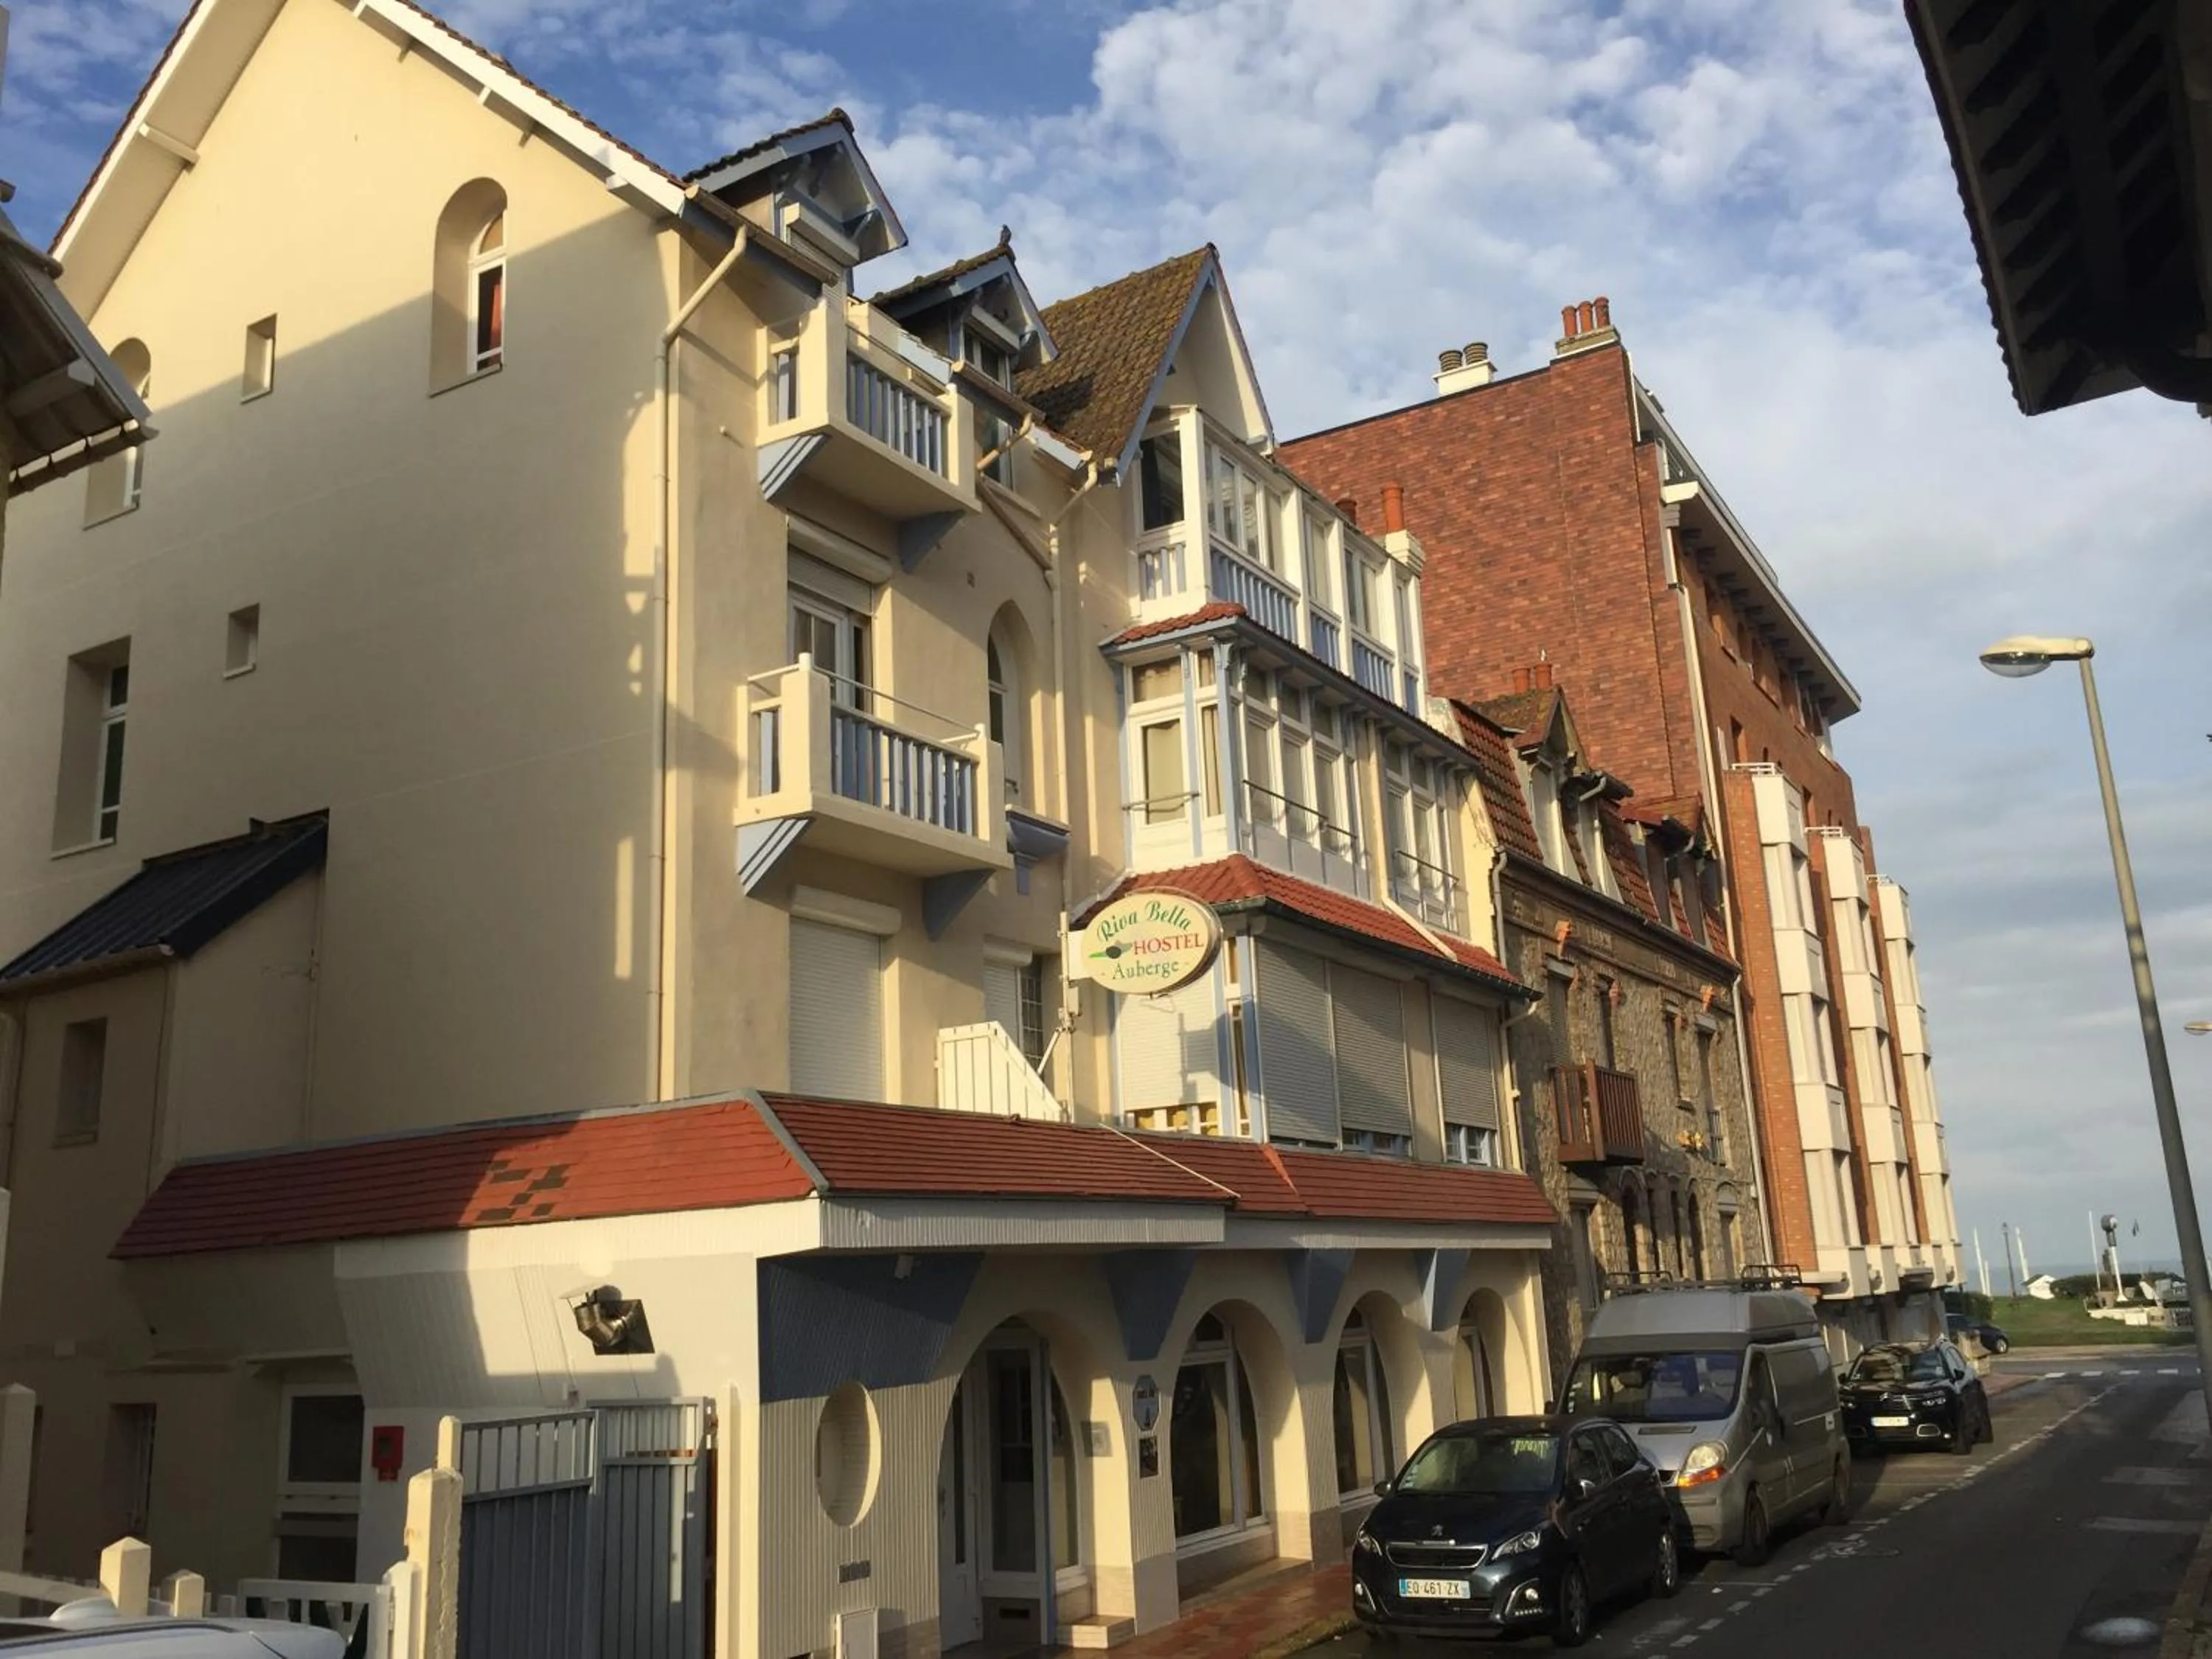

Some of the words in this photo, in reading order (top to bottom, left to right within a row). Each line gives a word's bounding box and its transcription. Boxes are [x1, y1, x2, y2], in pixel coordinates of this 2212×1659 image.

[1097, 911, 1138, 941] Riva
[1144, 900, 1192, 931] Bella
[1133, 933, 1204, 955] HOSTEL
[1113, 960, 1179, 980] Auberge
